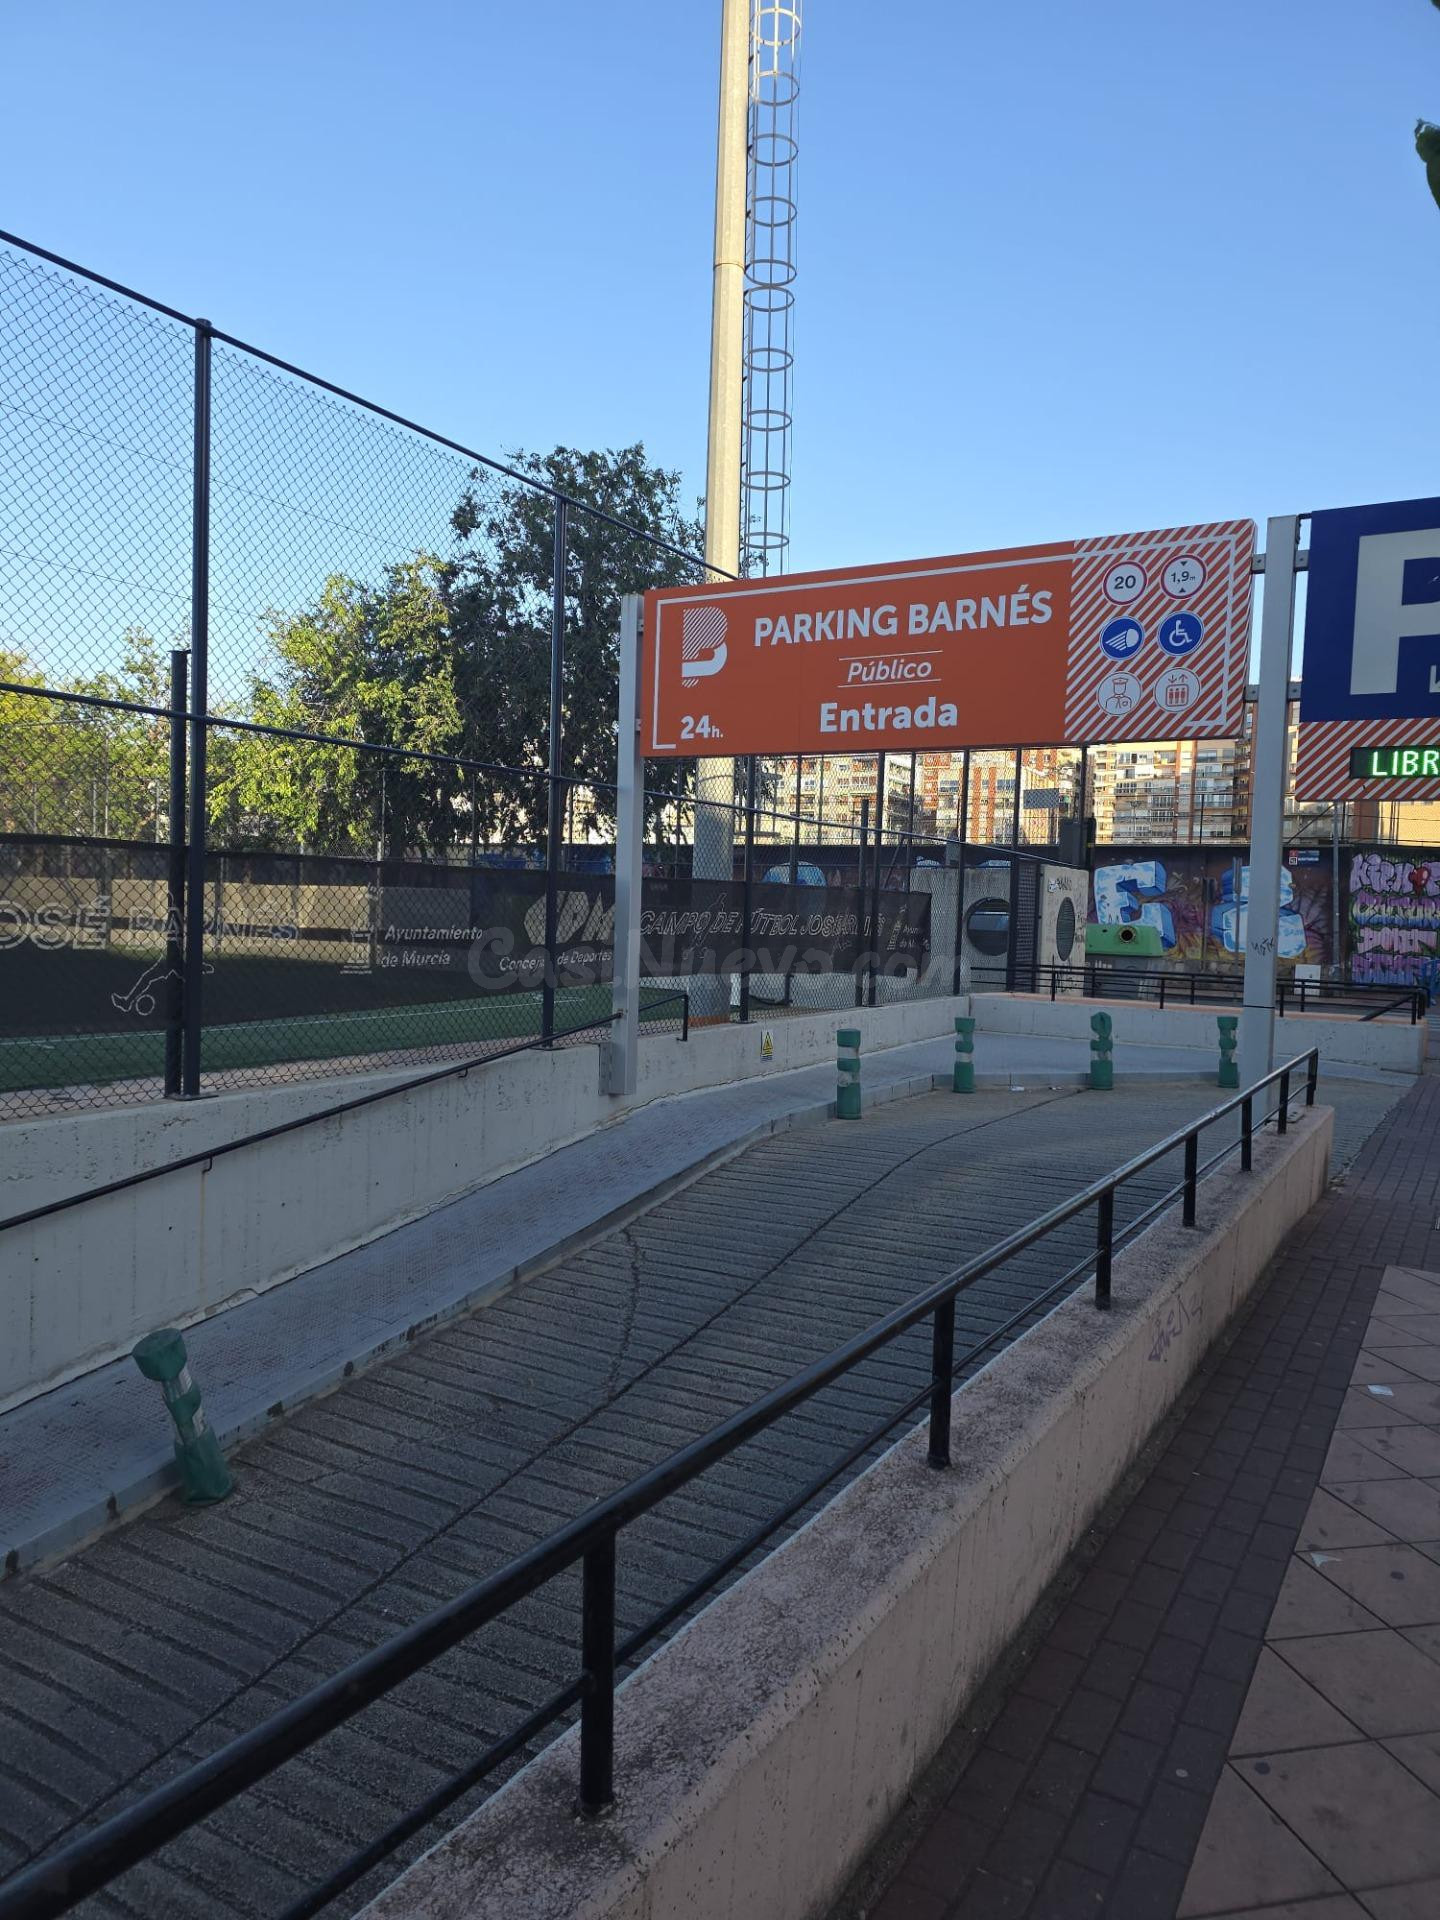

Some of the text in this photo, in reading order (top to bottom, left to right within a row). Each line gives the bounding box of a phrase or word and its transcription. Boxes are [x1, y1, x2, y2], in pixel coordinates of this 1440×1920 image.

[1114, 575, 1136, 590] 20
[754, 584, 1053, 647] PARKING BARNÉS
[847, 658, 932, 683] Público
[820, 696, 958, 733] Entrada
[384, 924, 483, 944] Ayuntamiento
[640, 911, 710, 935] CAMPO
[381, 948, 451, 968] de Murcia
[557, 951, 569, 966] de
[570, 949, 613, 967] Deportes
